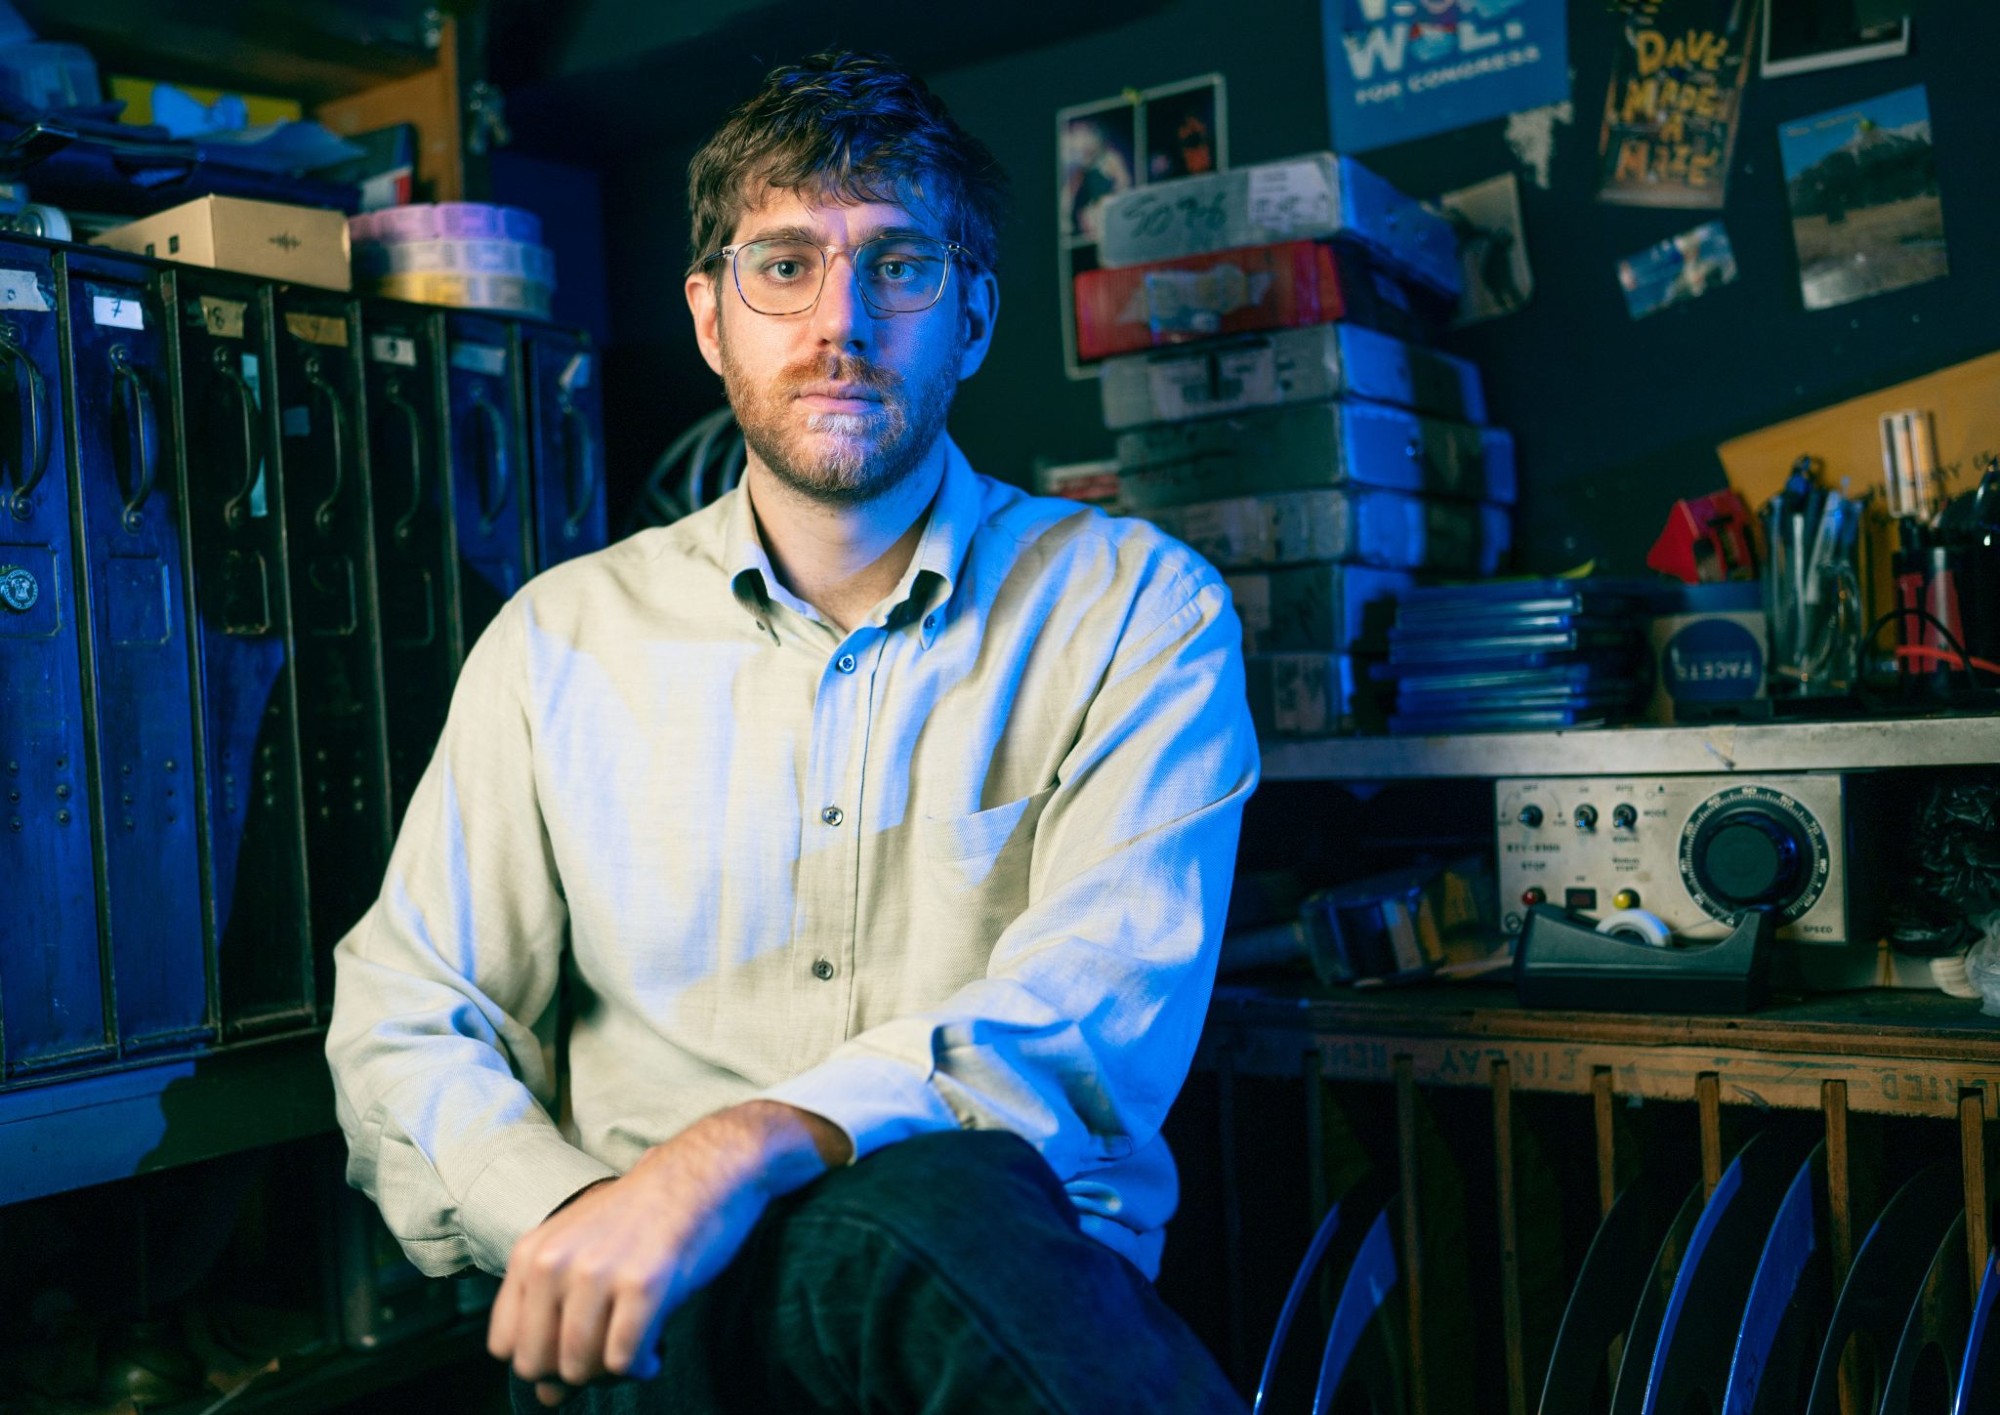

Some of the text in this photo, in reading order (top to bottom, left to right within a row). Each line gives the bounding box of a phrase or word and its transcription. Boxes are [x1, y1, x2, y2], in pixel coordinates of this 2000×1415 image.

[1635, 28, 1728, 76] DAVE
[1355, 43, 1541, 105] FOR CONGRESS
[1622, 78, 1718, 123] MADE
[1659, 112, 1683, 142] A
[1675, 658, 1755, 682] FACETS
[1802, 924, 1834, 934] SPEED
